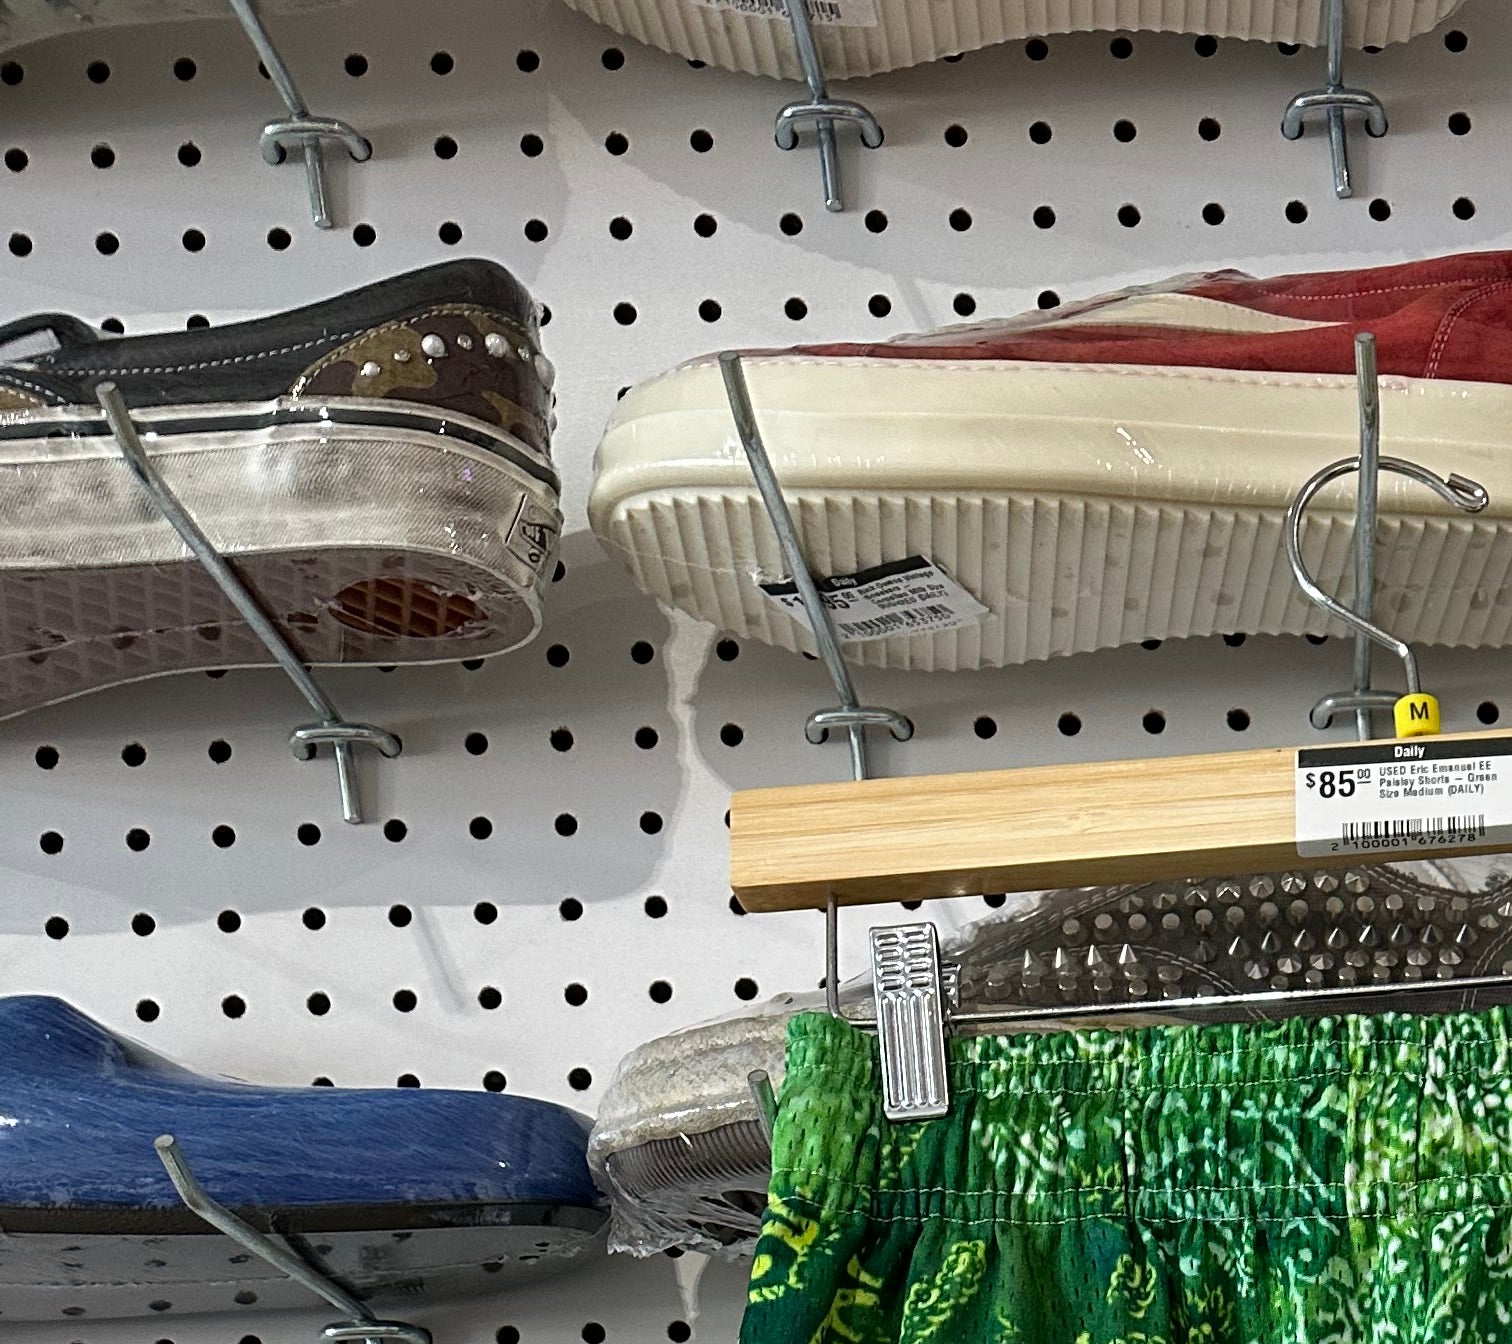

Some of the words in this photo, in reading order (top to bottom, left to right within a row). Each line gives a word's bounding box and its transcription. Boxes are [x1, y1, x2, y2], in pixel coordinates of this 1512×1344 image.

[1410, 702, 1430, 720] M
[1394, 745, 1426, 759] Daily
[1380, 765, 1406, 777] USED
[1410, 764, 1429, 775] Eric
[1432, 762, 1476, 774] Emanuel
[1479, 760, 1492, 771] EE
[1379, 789, 1399, 799] Size
[1403, 786, 1443, 797] Medium
[1447, 783, 1485, 797] (DAILY)
[1380, 777, 1415, 791] Paisley
[1418, 775, 1450, 785] Shorts
